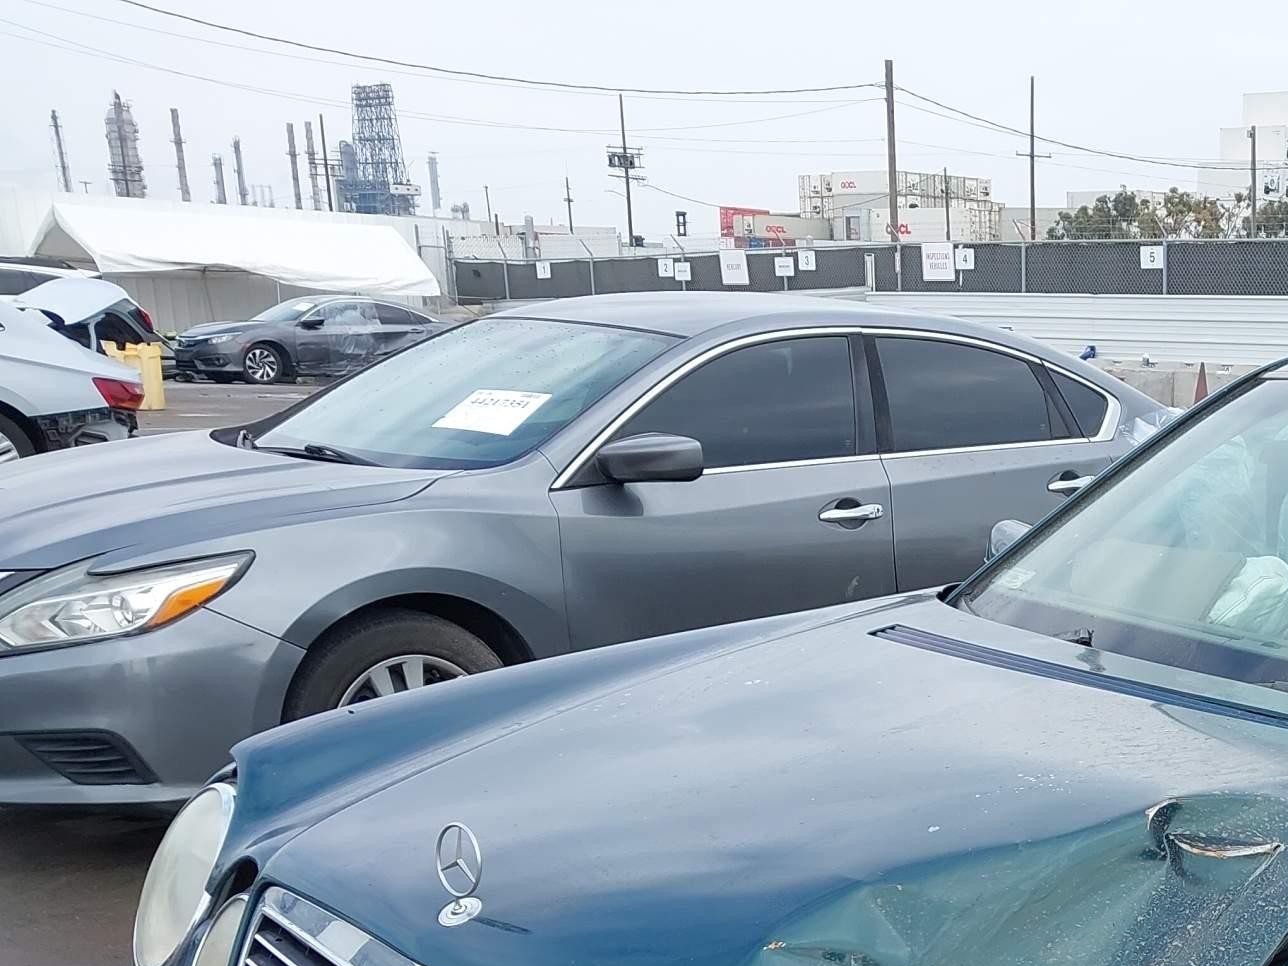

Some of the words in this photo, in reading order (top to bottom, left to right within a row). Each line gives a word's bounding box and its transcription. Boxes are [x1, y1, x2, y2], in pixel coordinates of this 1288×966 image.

[804, 255, 810, 266] 3
[962, 254, 968, 264] 4
[1149, 251, 1155, 263] 5
[663, 264, 669, 273] 2
